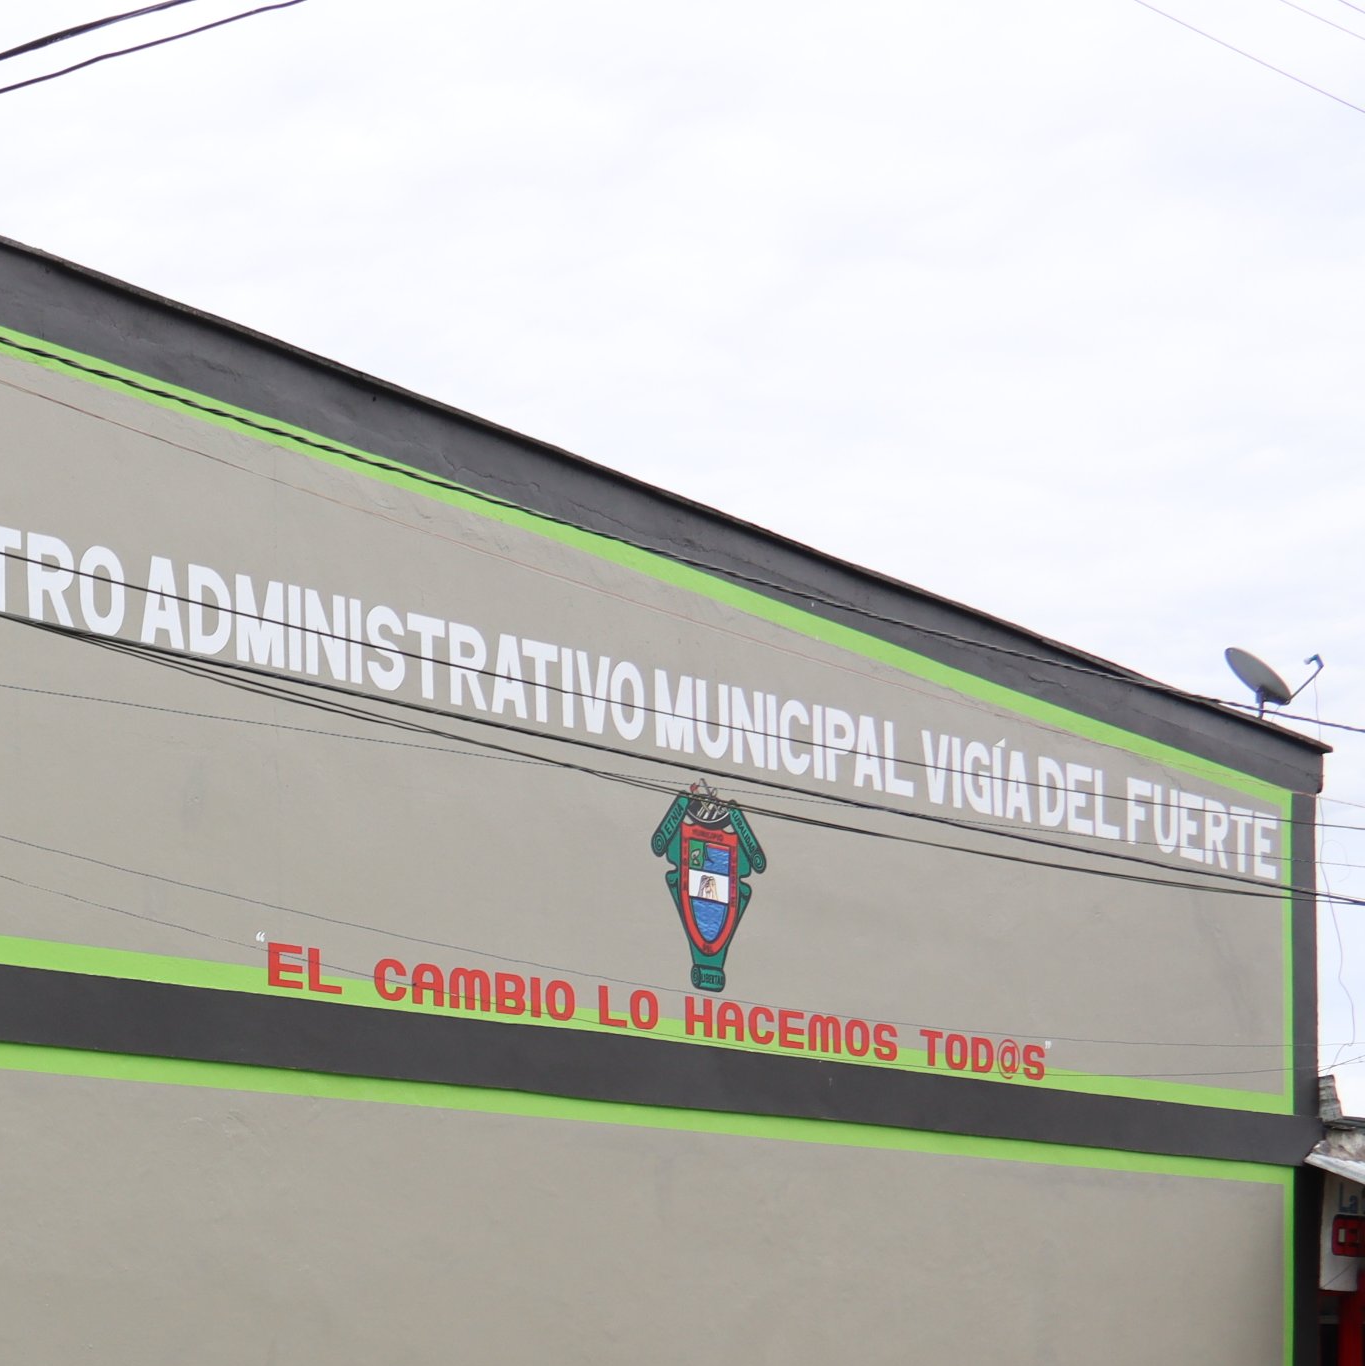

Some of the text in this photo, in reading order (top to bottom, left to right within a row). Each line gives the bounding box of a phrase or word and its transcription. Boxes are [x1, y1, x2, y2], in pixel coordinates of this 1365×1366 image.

[139, 555, 645, 742] ADMINISTRATIVO
[654, 669, 916, 799] MUNICIPAL
[921, 737, 1033, 829] VIGÍA
[1038, 756, 1122, 840] DEL
[1125, 777, 1277, 881] FUERTE
[373, 958, 577, 1022] CAMBIO
[598, 985, 659, 1031] LO
[685, 996, 899, 1062] HACEMOS
